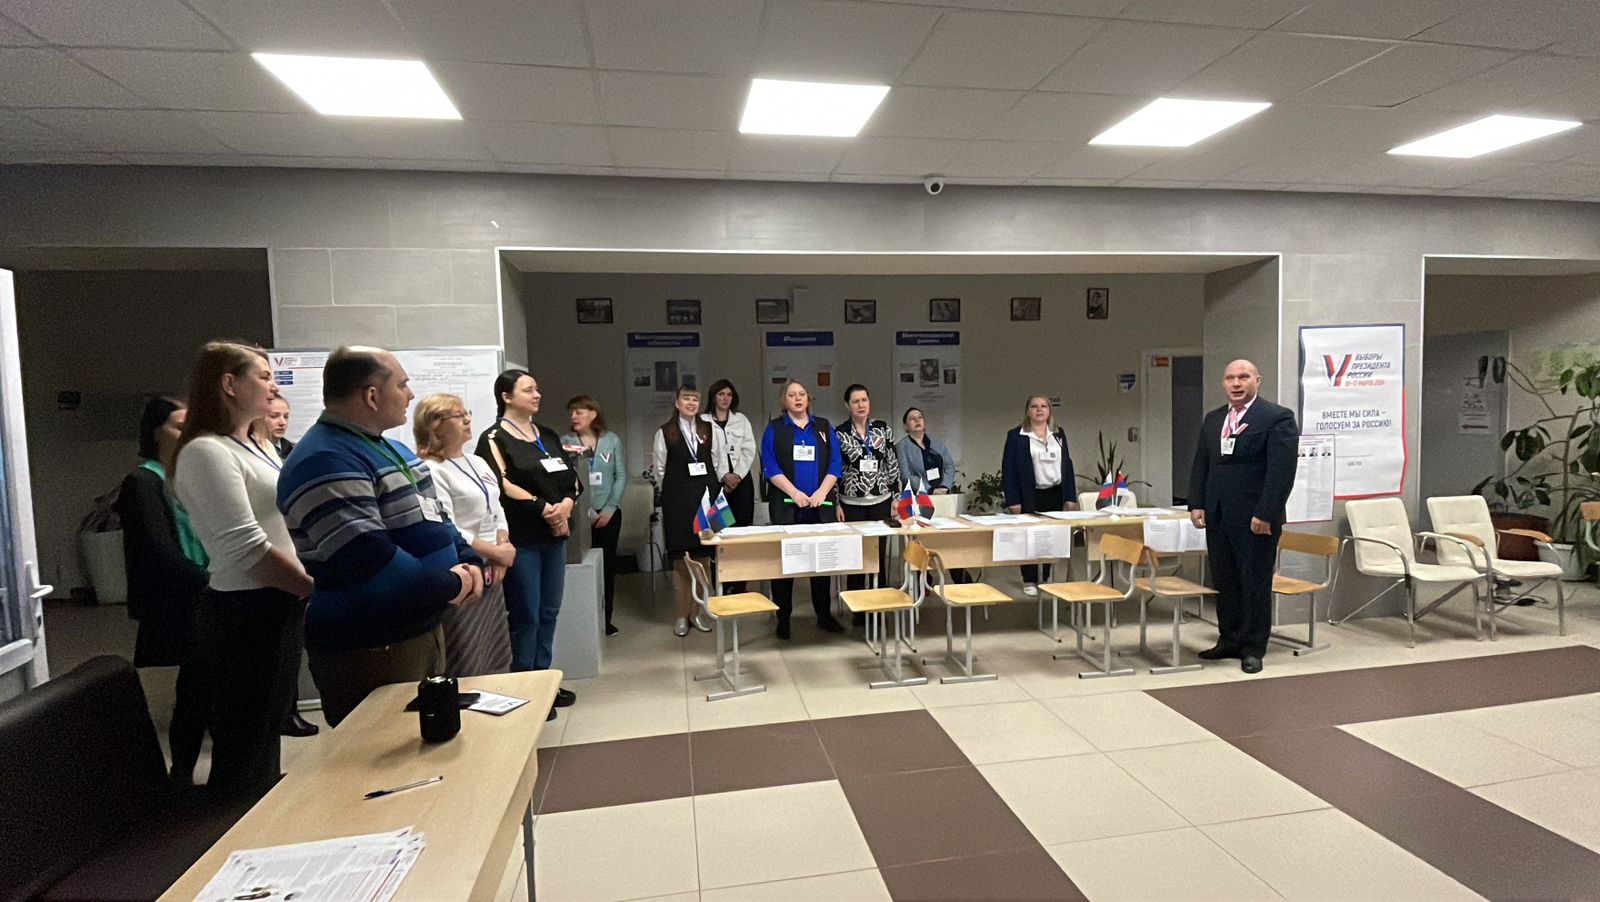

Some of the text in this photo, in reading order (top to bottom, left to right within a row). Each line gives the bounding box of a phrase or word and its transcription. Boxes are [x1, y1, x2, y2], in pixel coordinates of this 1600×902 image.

[1355, 353, 1384, 361] ВЫБОРЫ
[1351, 361, 1391, 370] ПРЕЗИДЕНТА
[1347, 371, 1374, 379] РОССИИ
[1322, 410, 1348, 420] ВМЕСТЕ
[1349, 410, 1361, 419] МЫ
[1362, 409, 1380, 418] СИЛА
[1316, 419, 1392, 431] ГОЛОСУЕМ ЗА РОССИЮ!
